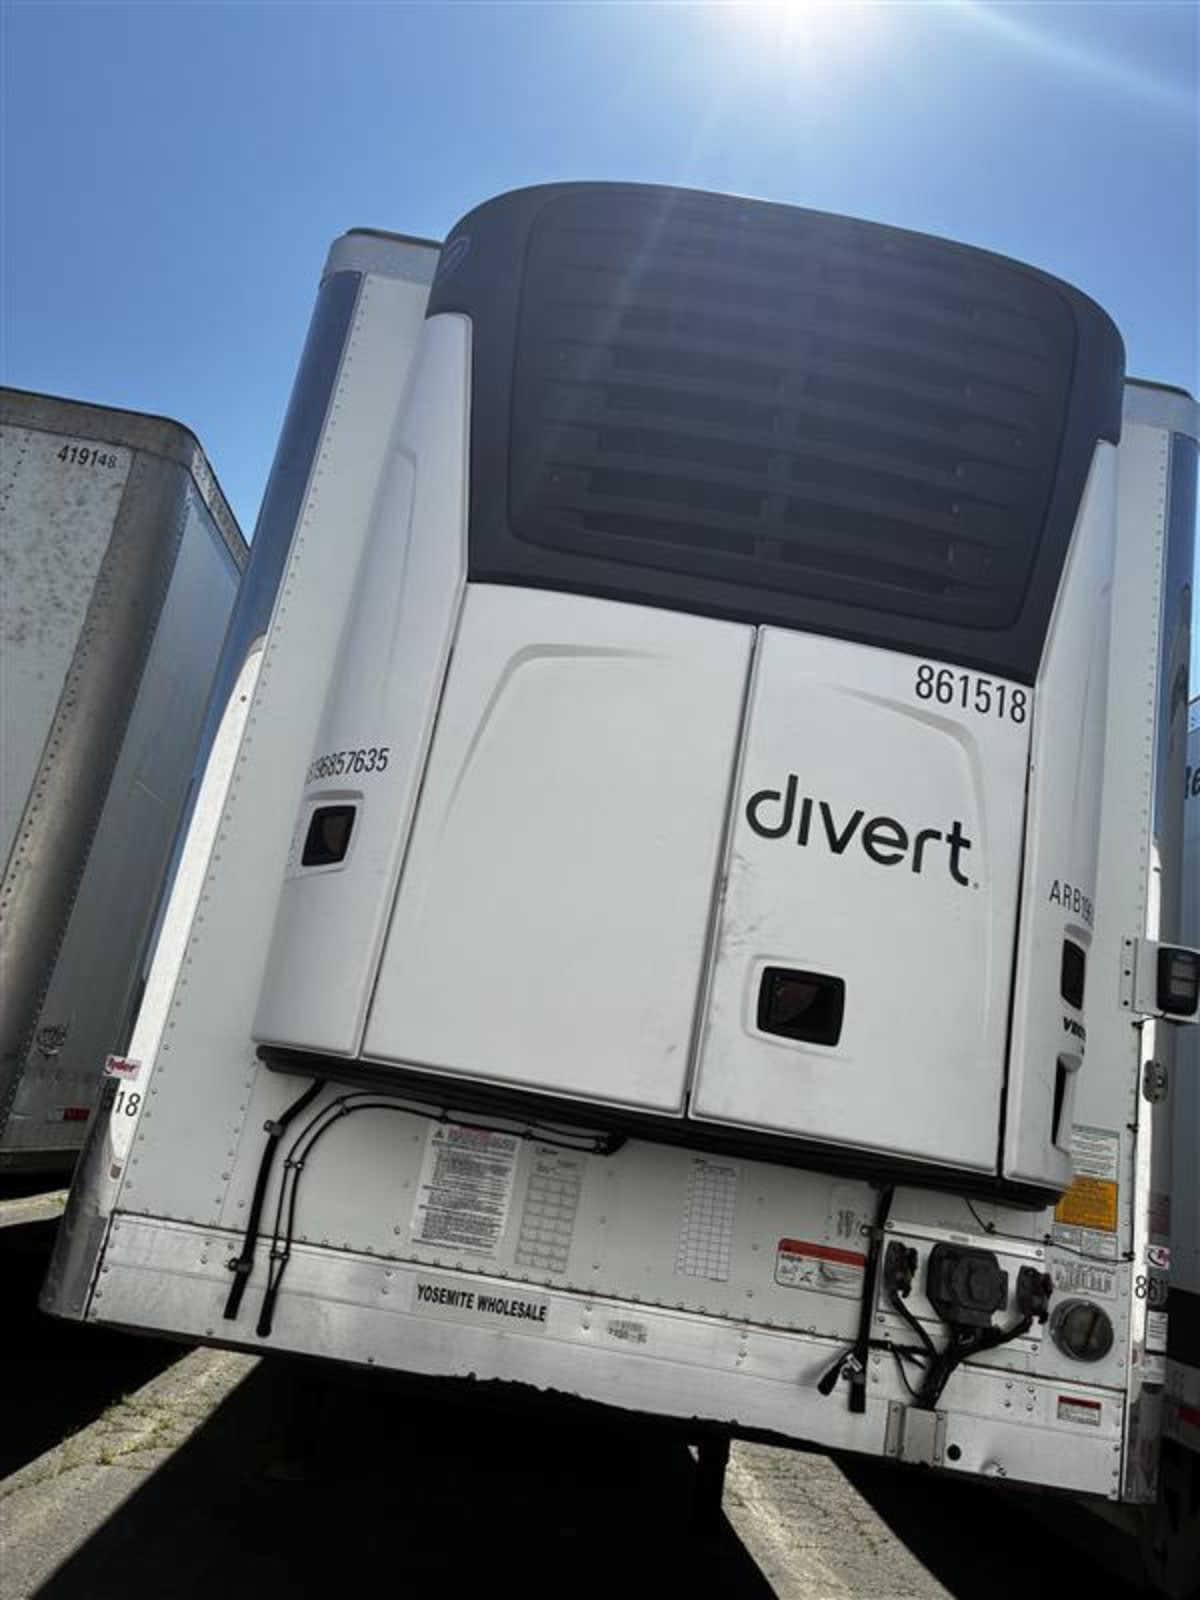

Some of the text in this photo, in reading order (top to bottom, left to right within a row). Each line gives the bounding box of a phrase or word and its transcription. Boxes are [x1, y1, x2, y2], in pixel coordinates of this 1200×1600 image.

[57, 445, 118, 469] 419148
[915, 664, 1027, 724] 861518
[745, 774, 972, 887] divert
[417, 1283, 548, 1323] YOSEMITE WHOLESALE
